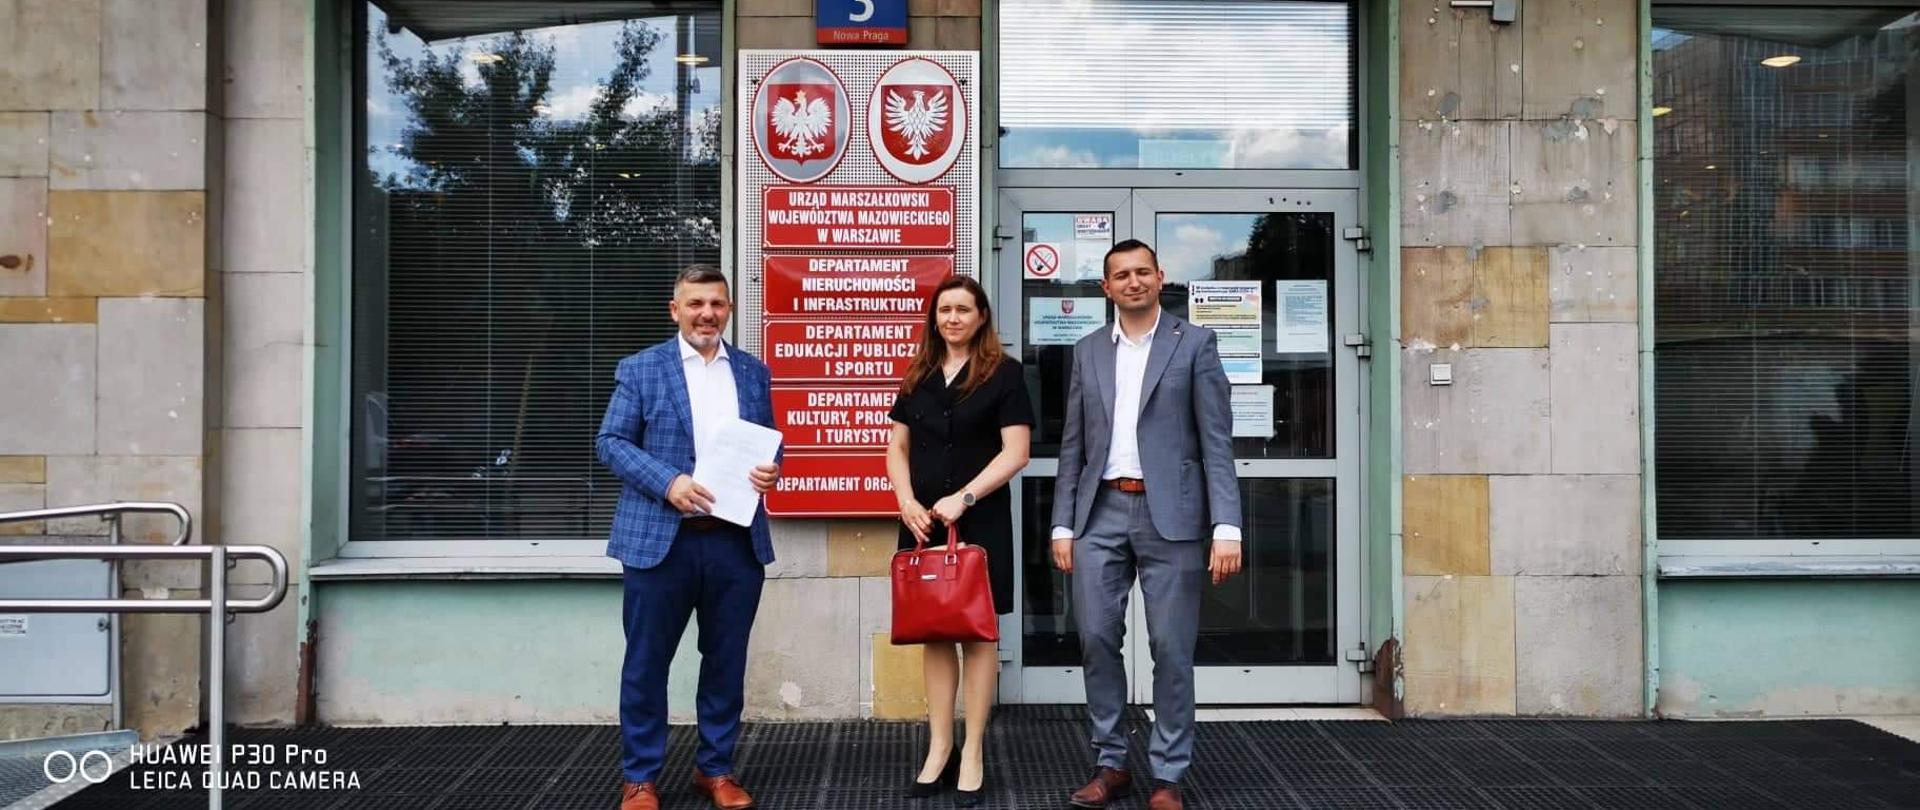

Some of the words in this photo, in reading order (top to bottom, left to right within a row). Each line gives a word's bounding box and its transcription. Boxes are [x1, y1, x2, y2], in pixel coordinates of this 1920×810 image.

[833, 30, 860, 41] Nowa
[863, 30, 889, 43] Praga
[789, 192, 827, 209] URZĄD
[831, 192, 930, 207] MARSZAŁKOWSKI
[768, 207, 855, 225] WOJEWÓDZTWA
[858, 210, 950, 225] MAZOWIECKIEGO
[817, 229, 828, 243] W
[832, 229, 901, 243] WARSZAWIE
[809, 258, 909, 272] DEPARTAMENT
[802, 276, 916, 292] NIERUCHOMOŚCI
[793, 298, 799, 311] I
[803, 298, 924, 311] INFRASTRUKTURY
[806, 325, 913, 339] DEPARTAMENT
[775, 344, 848, 358] EDUKACJI
[825, 361, 830, 375] I
[835, 361, 893, 376] SPORTU
[787, 411, 850, 427] KULTURY,
[816, 429, 821, 443] I
[776, 477, 861, 491] DEPARTAMENT
